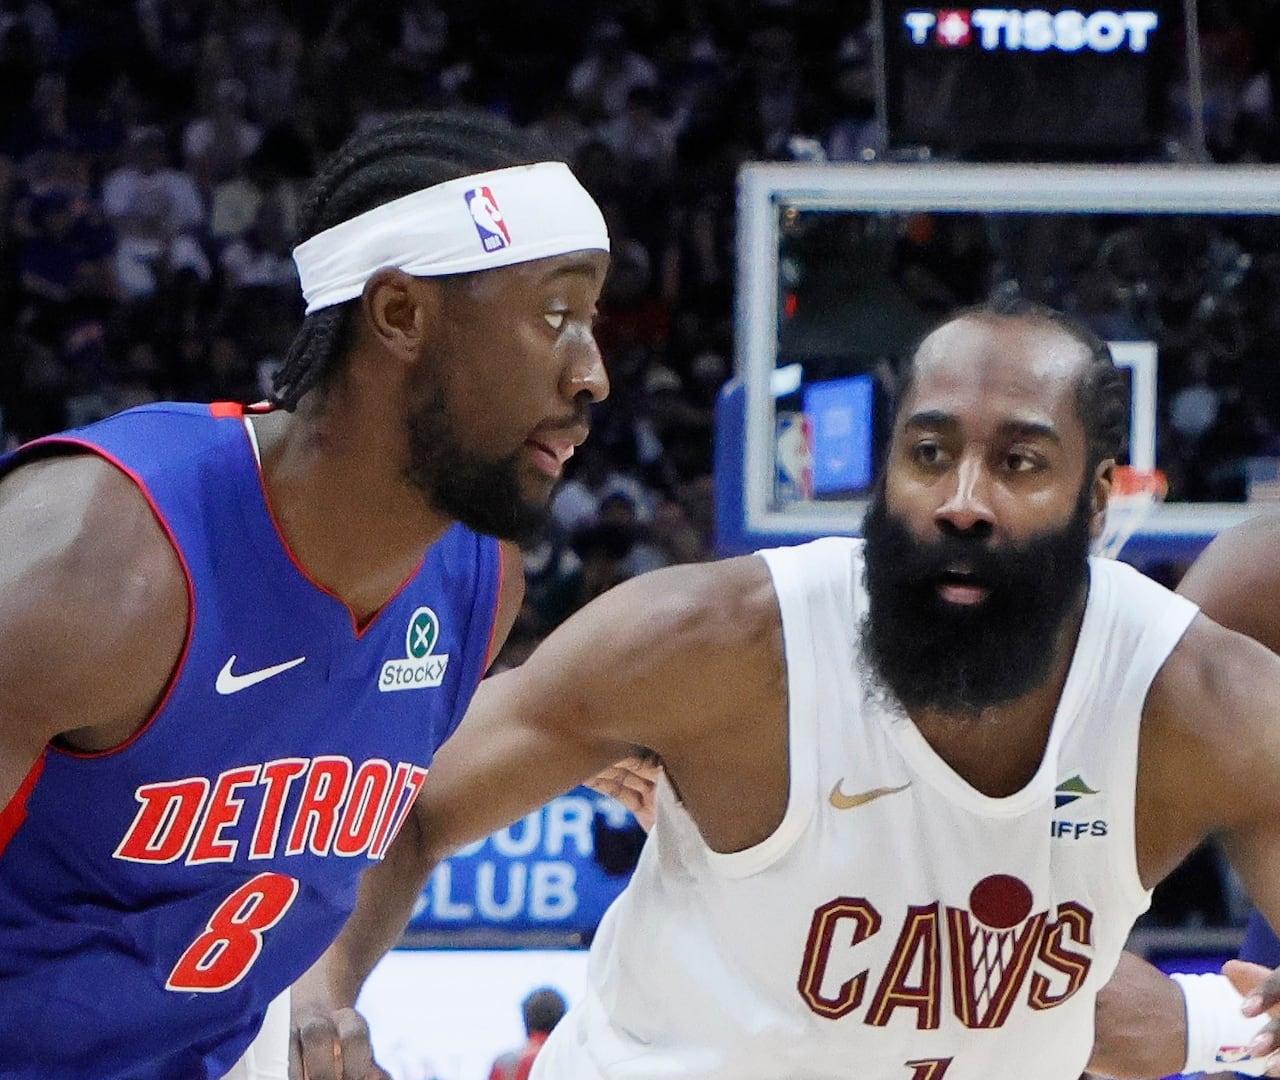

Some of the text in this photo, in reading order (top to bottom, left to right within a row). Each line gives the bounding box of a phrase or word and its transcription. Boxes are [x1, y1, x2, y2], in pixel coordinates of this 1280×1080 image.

[971, 8, 1159, 53] TISSOT
[453, 796, 594, 859] UR
[412, 859, 580, 922] LUB
[165, 871, 300, 993] 8
[796, 893, 1094, 1031] CAVS
